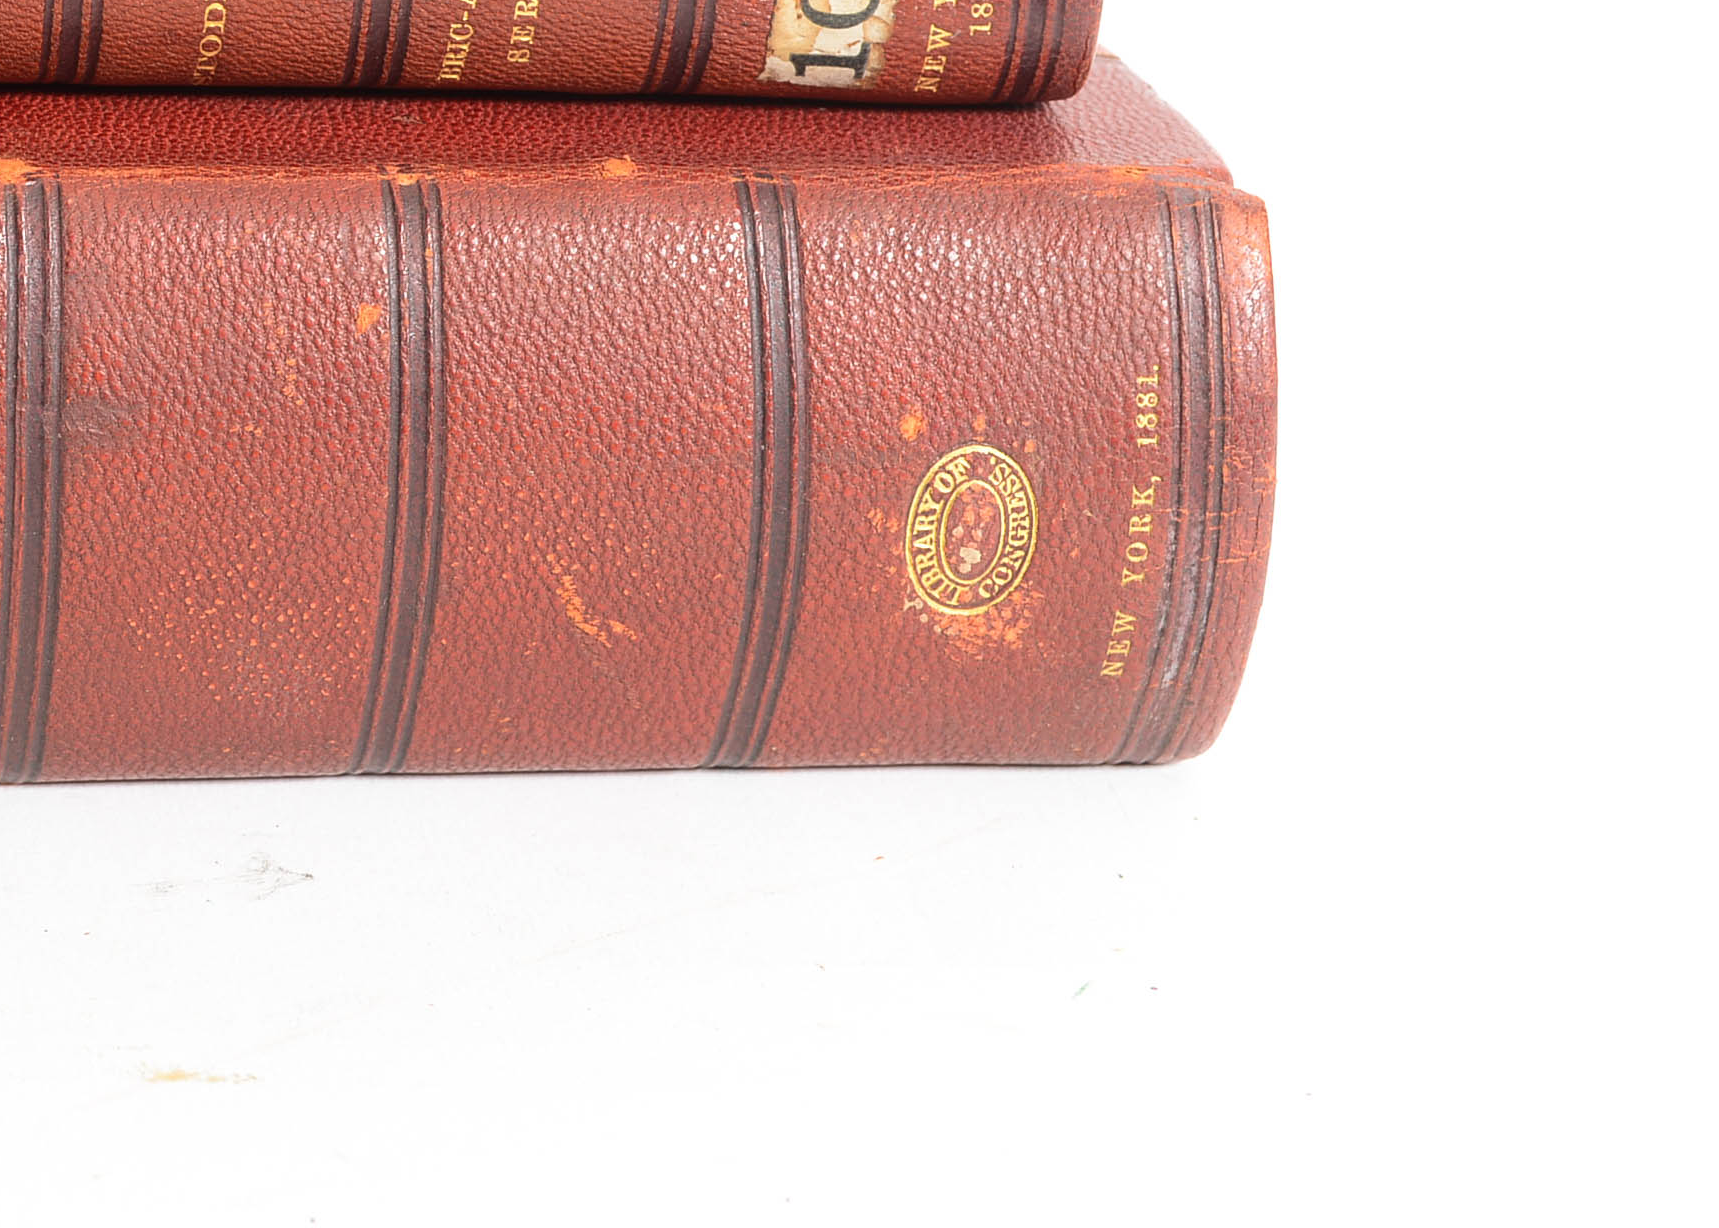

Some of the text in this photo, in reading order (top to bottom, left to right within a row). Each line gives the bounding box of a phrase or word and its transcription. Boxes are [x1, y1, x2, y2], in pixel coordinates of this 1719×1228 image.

[913, 23, 955, 93] NEW
[933, 456, 972, 494] OF
[1100, 364, 1164, 678] NEW YORK, 1881.
[912, 486, 971, 606] LIBRARY
